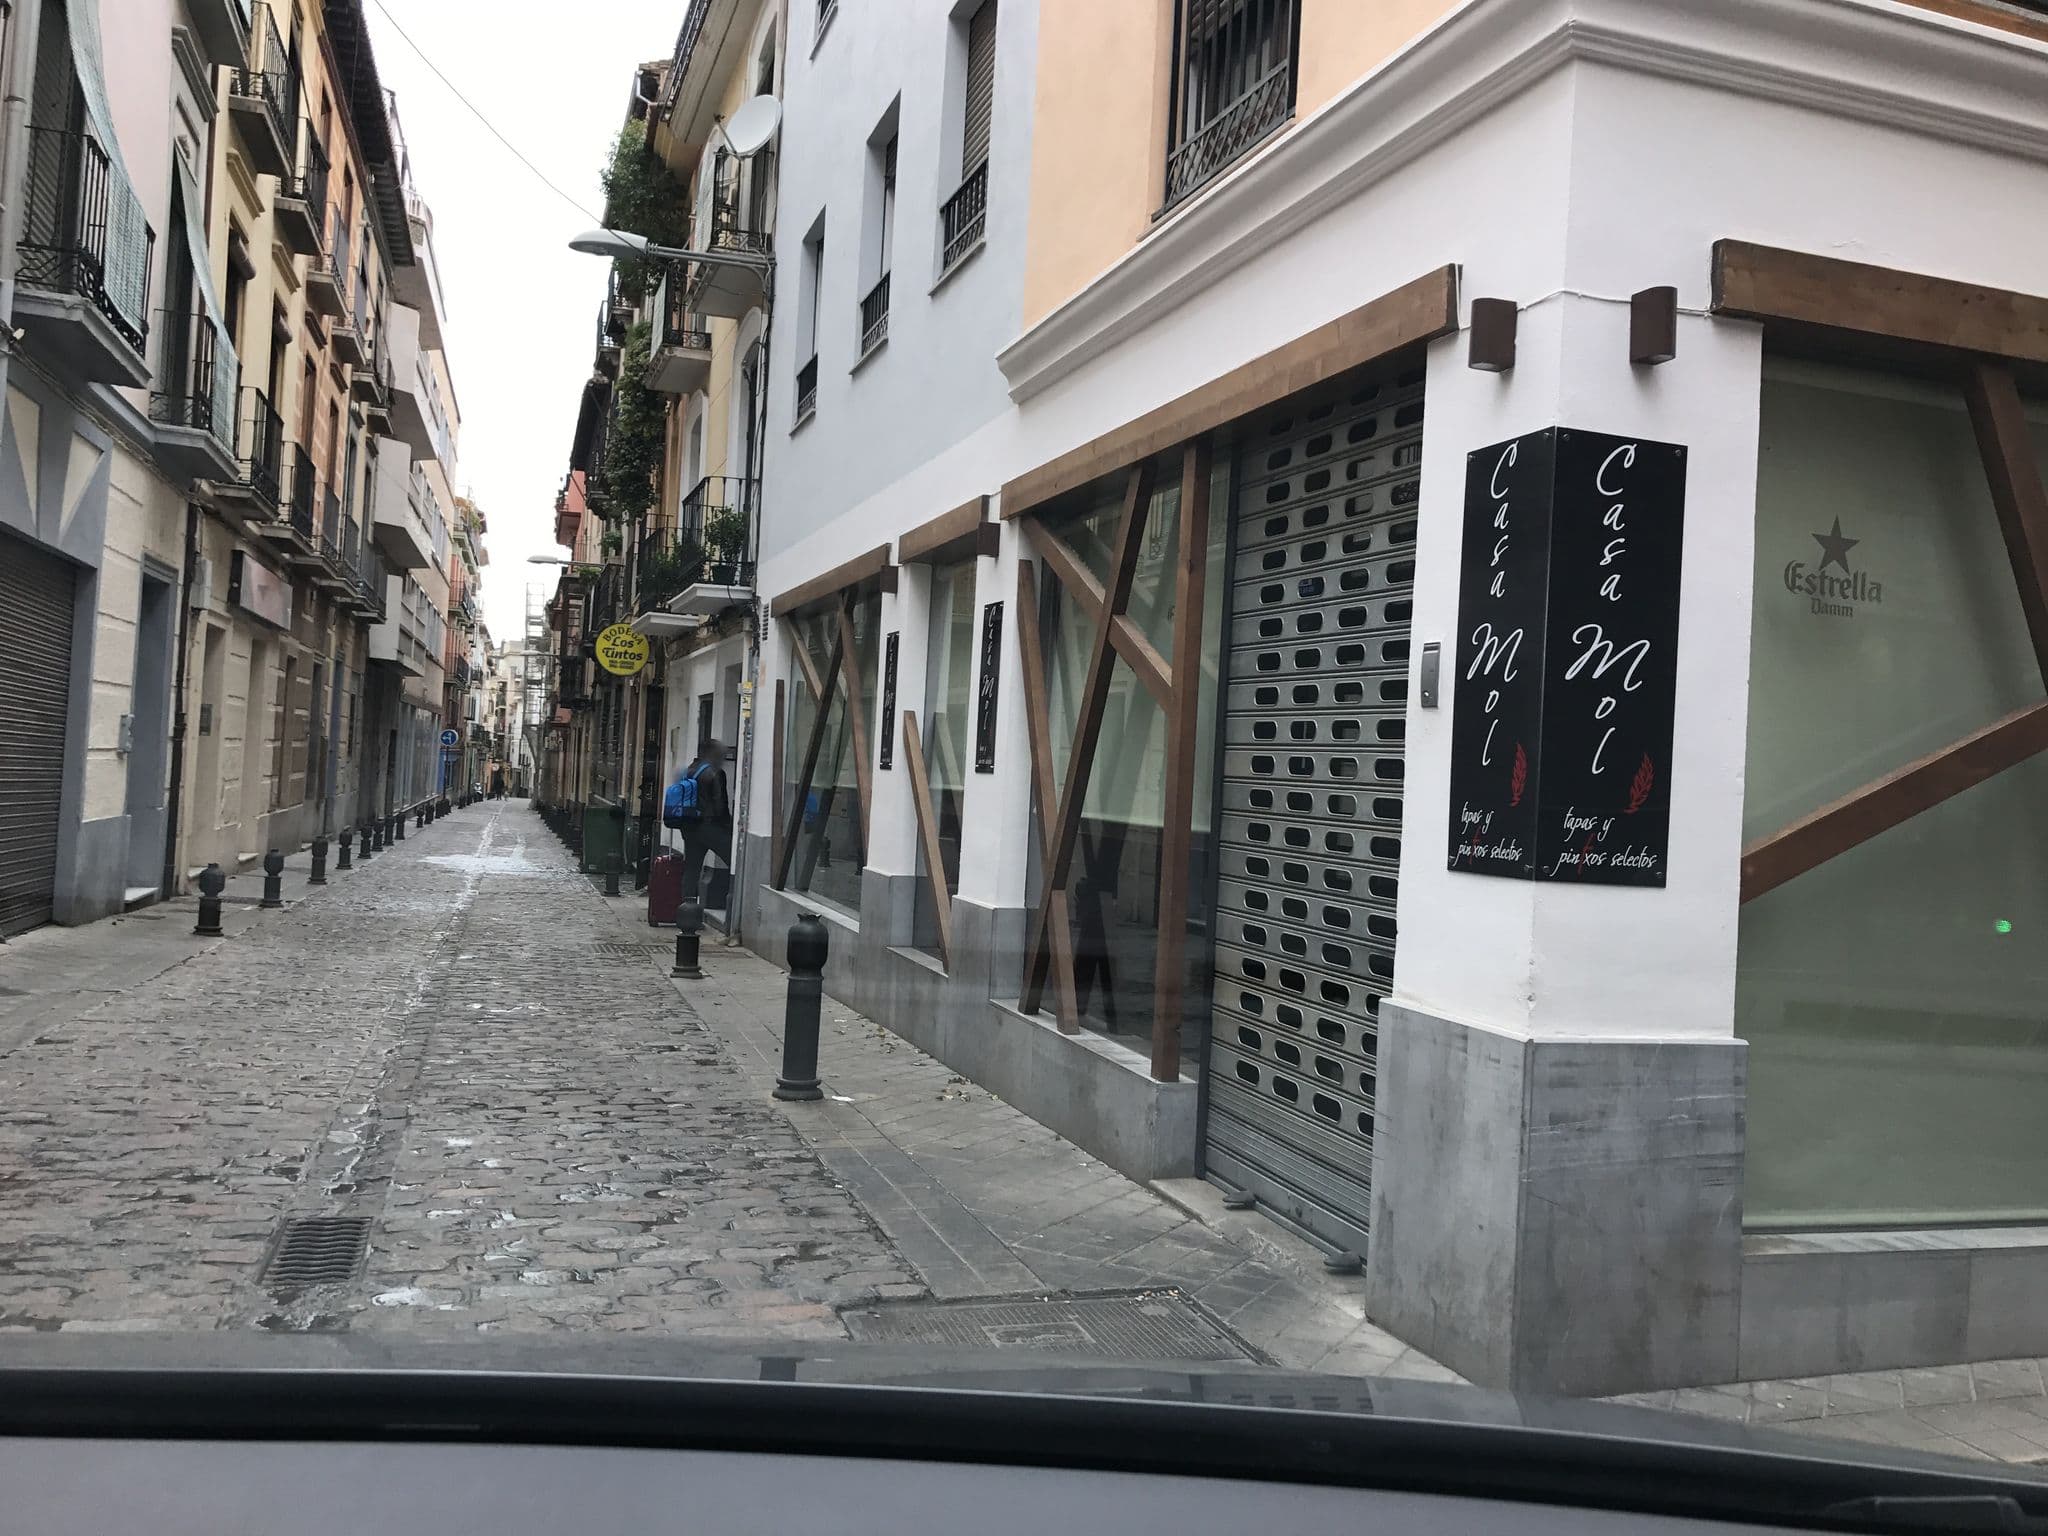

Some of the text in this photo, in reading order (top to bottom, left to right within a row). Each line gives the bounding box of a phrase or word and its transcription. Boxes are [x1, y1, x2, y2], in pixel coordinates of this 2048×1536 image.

[1490, 440, 1518, 598] Casa
[1595, 442, 1638, 602] Casa
[1783, 559, 1882, 603] Estrella
[1810, 597, 1854, 618] Damm
[603, 626, 644, 645] BODEGA
[611, 636, 634, 648] Los
[602, 647, 643, 661] Tintos
[1466, 622, 1524, 767] Mol
[1564, 623, 1651, 775] Mol
[1461, 801, 1495, 834] tapas y
[1563, 806, 1615, 842] tapas y
[1489, 838, 1523, 862] selectos
[1610, 844, 1658, 869] selectos
